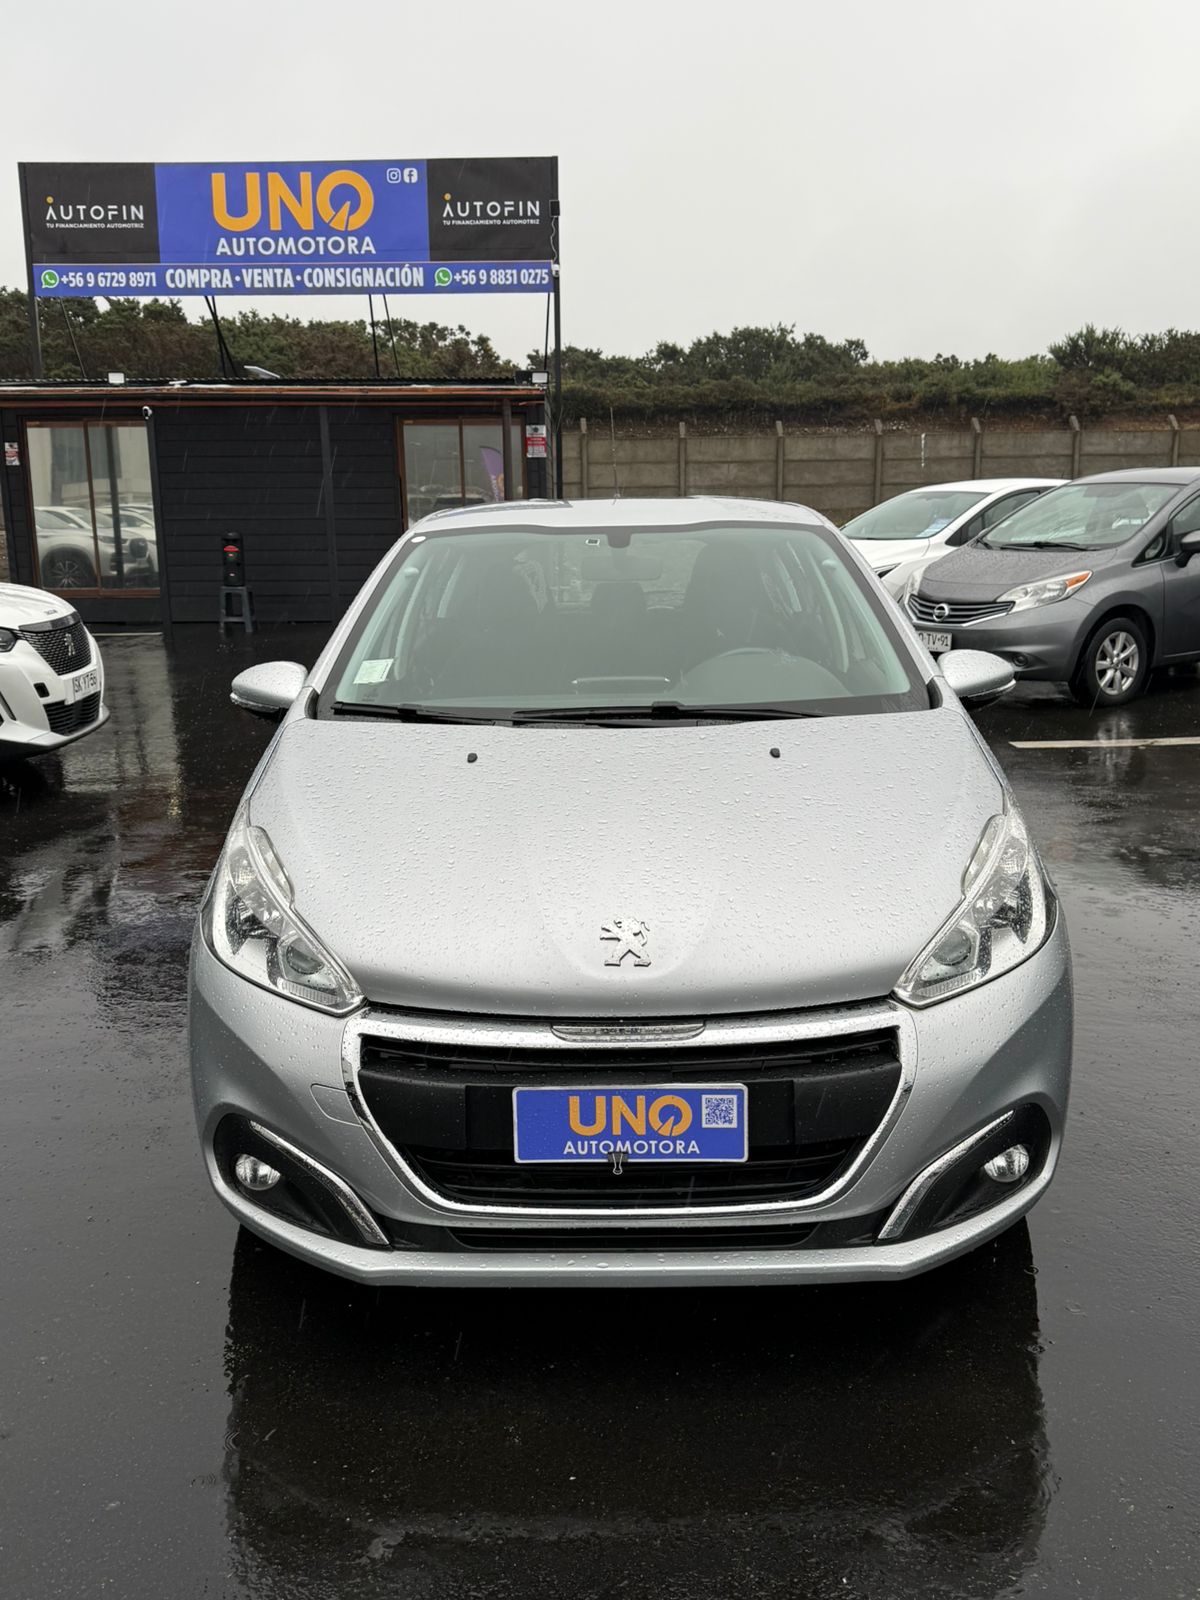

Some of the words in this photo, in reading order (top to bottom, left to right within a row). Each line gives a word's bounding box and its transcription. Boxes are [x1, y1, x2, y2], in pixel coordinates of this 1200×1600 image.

[45, 199, 144, 221] AUTOFIN
[211, 169, 375, 232] UNO
[442, 195, 540, 218] AUTOFIN
[215, 236, 377, 256] AUTOMOTORA
[60, 271, 84, 288] +56
[87, 271, 95, 288] 9
[98, 271, 127, 287] 6729
[129, 271, 157, 287] 8971
[453, 269, 476, 285] +56
[478, 269, 487, 285] 9
[490, 268, 518, 285] 8831
[520, 268, 549, 284] 0275
[568, 1094, 693, 1137] UNO
[563, 1140, 700, 1155] AUTOMOTORA
